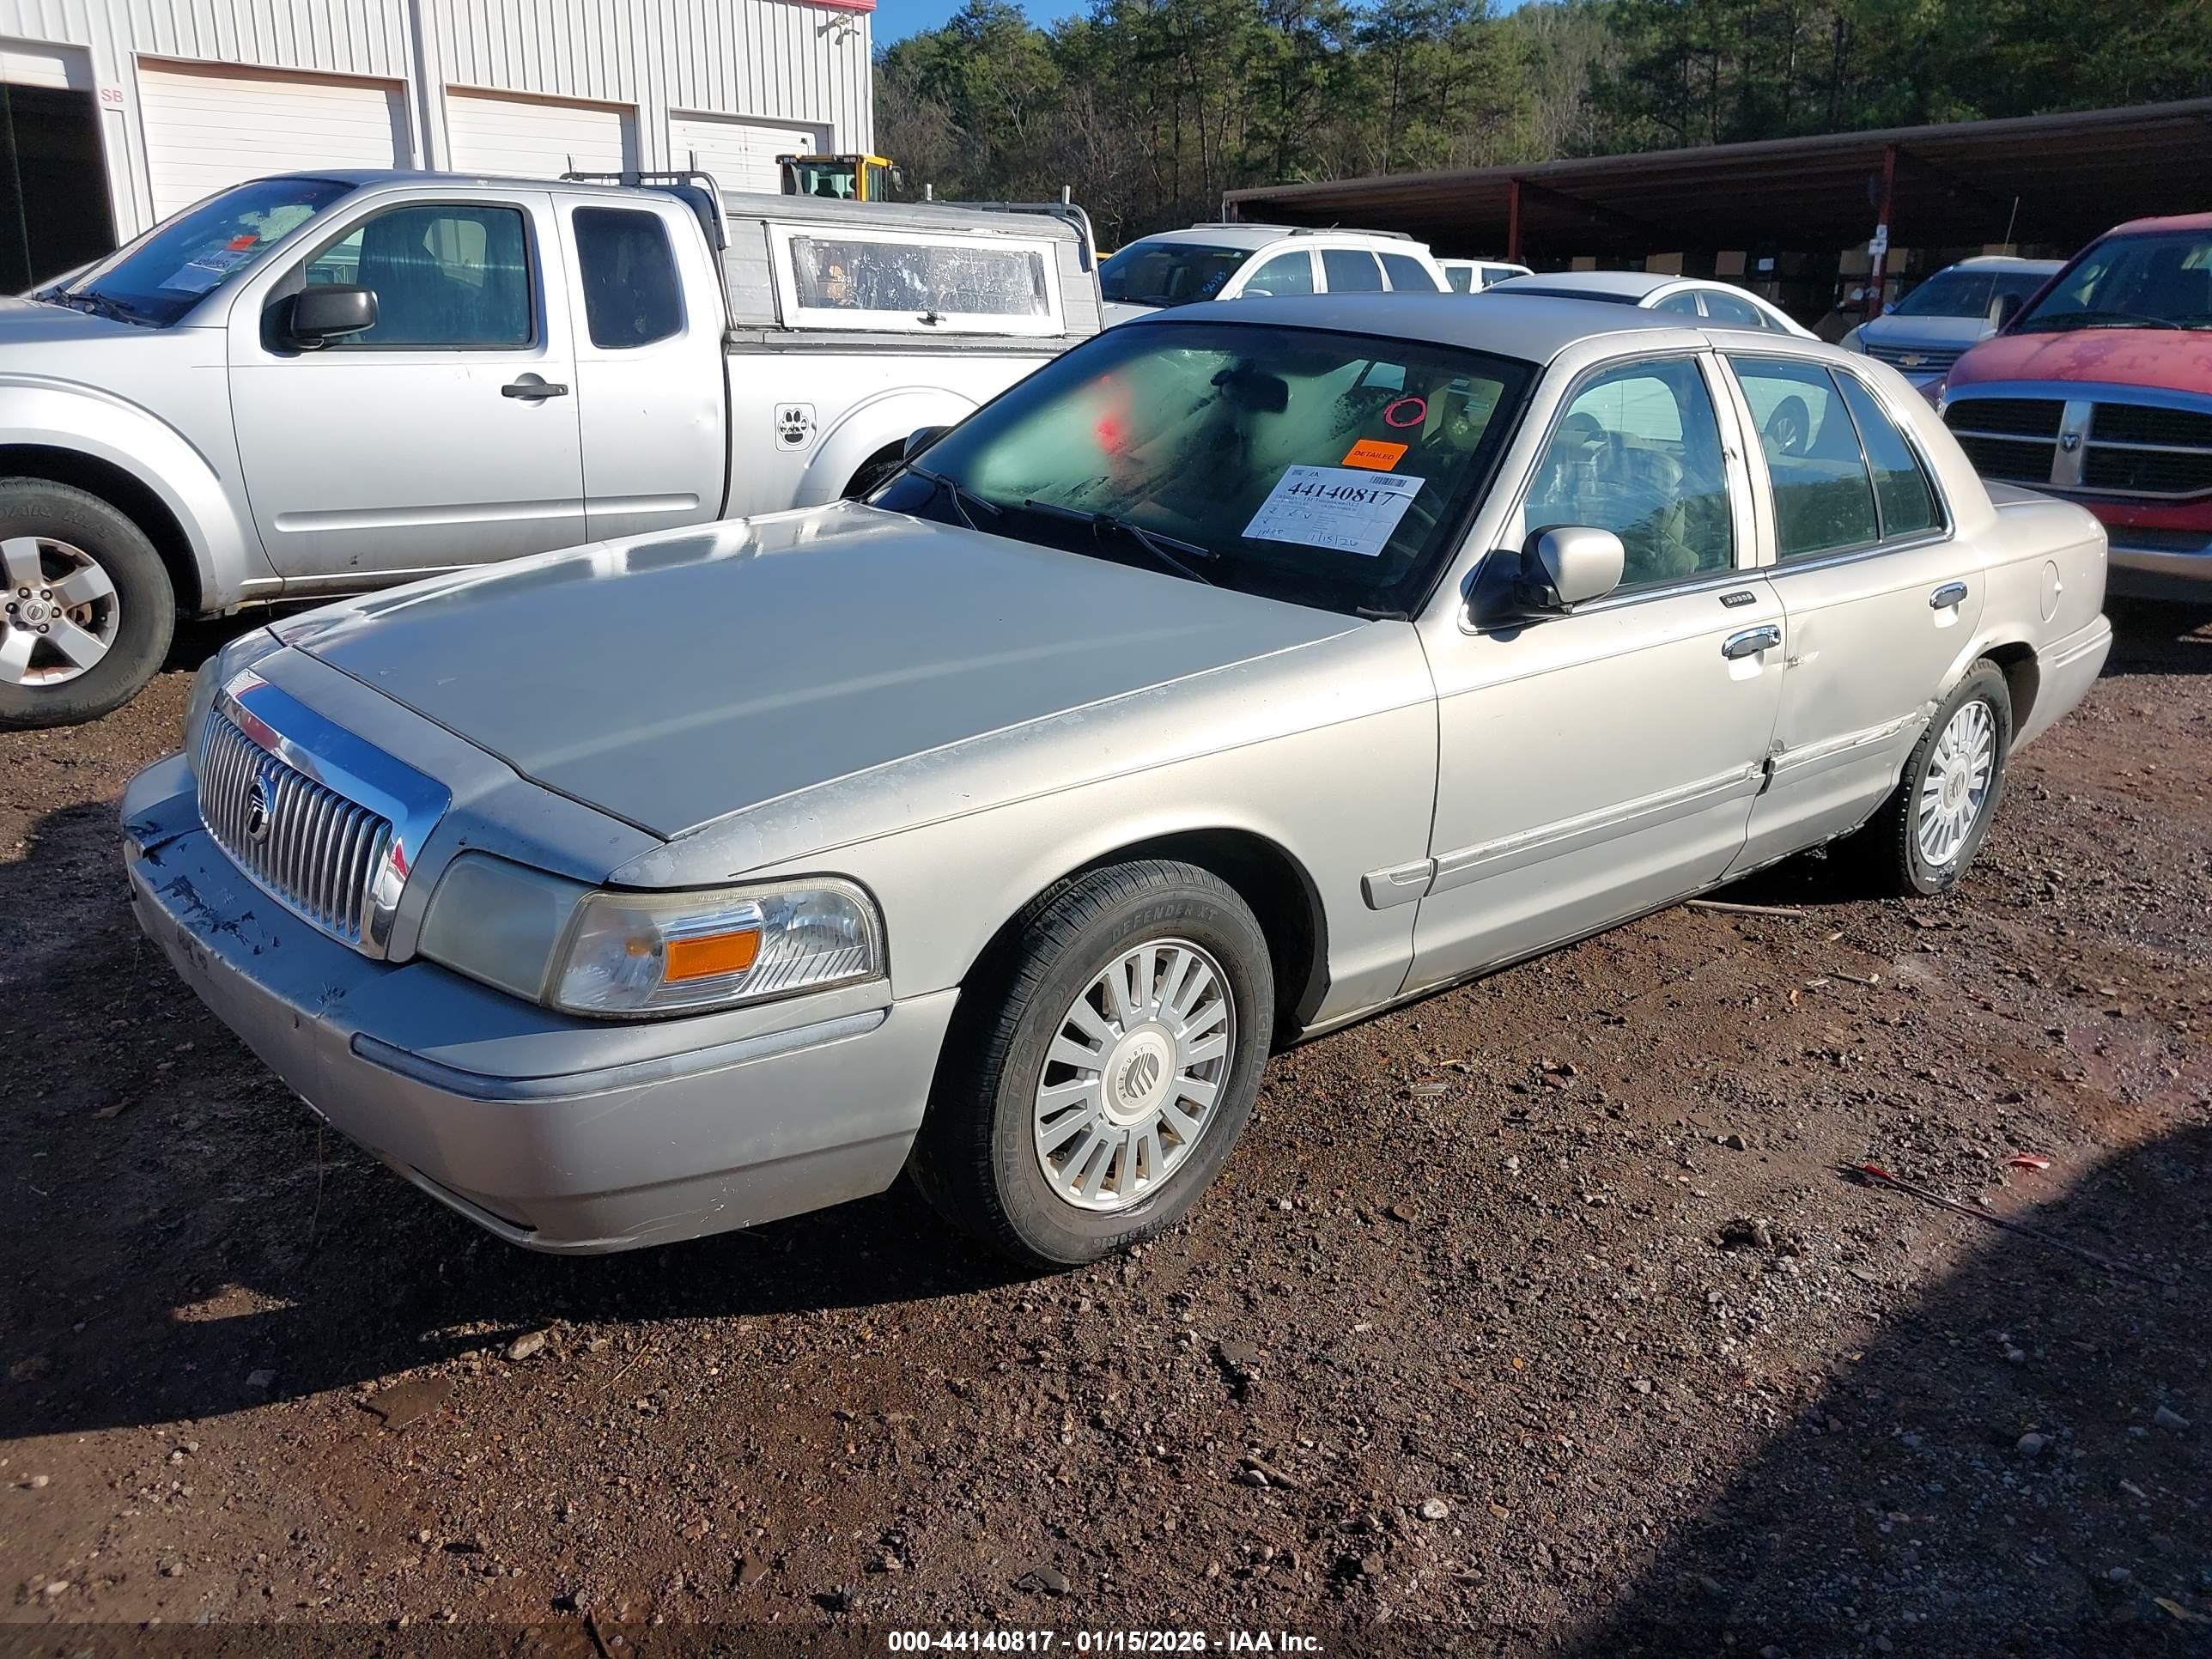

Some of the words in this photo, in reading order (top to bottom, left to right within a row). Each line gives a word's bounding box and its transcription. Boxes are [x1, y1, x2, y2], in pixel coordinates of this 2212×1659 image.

[101, 89, 124, 103] SB
[1353, 450, 1395, 460] DETAILED
[1288, 482, 1397, 507] 44140817
[1112, 904, 1193, 942] DEFENDER
[1197, 904, 1218, 921] XT
[1119, 1047, 1145, 1100] MERCURY
